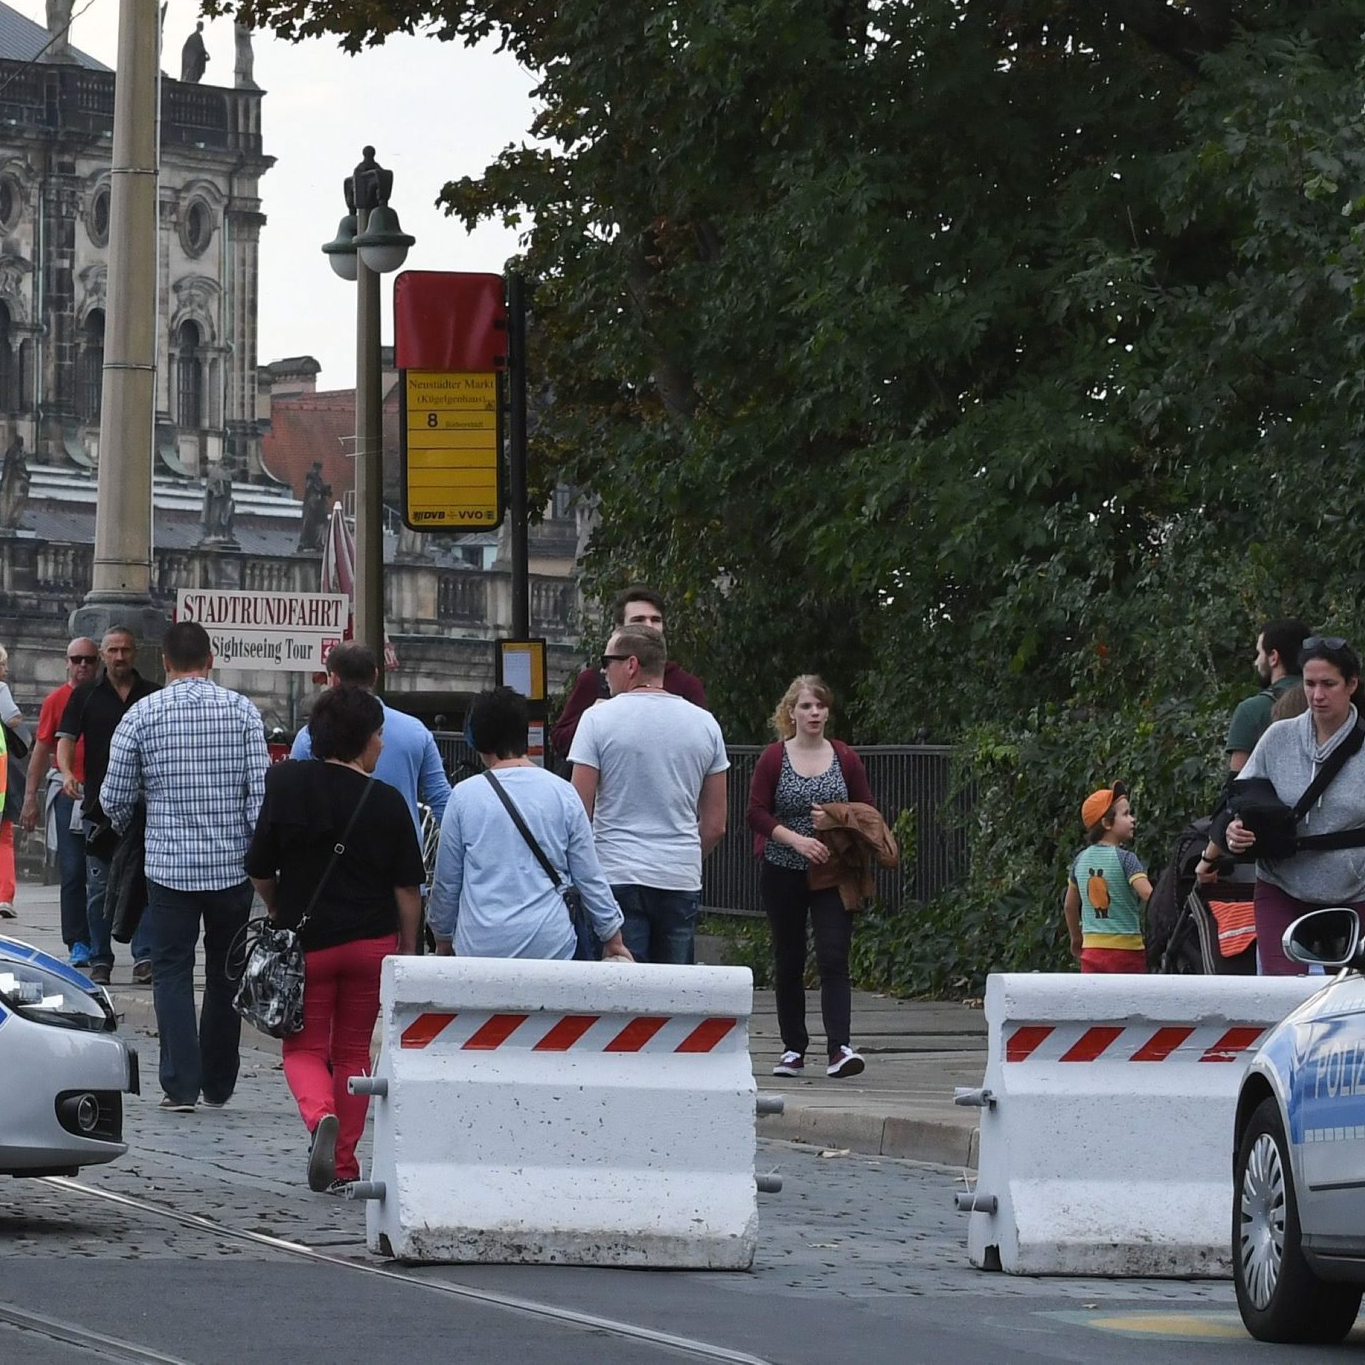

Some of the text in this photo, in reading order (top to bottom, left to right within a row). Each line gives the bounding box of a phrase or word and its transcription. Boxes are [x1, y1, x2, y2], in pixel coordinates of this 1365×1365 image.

[464, 379, 494, 389] Markt
[427, 413, 438, 428] 8
[423, 511, 445, 520] DVB
[458, 510, 483, 520] VVO
[183, 594, 342, 627] STADTRUNDFAHRT
[211, 635, 313, 664] Sightseeing Tour
